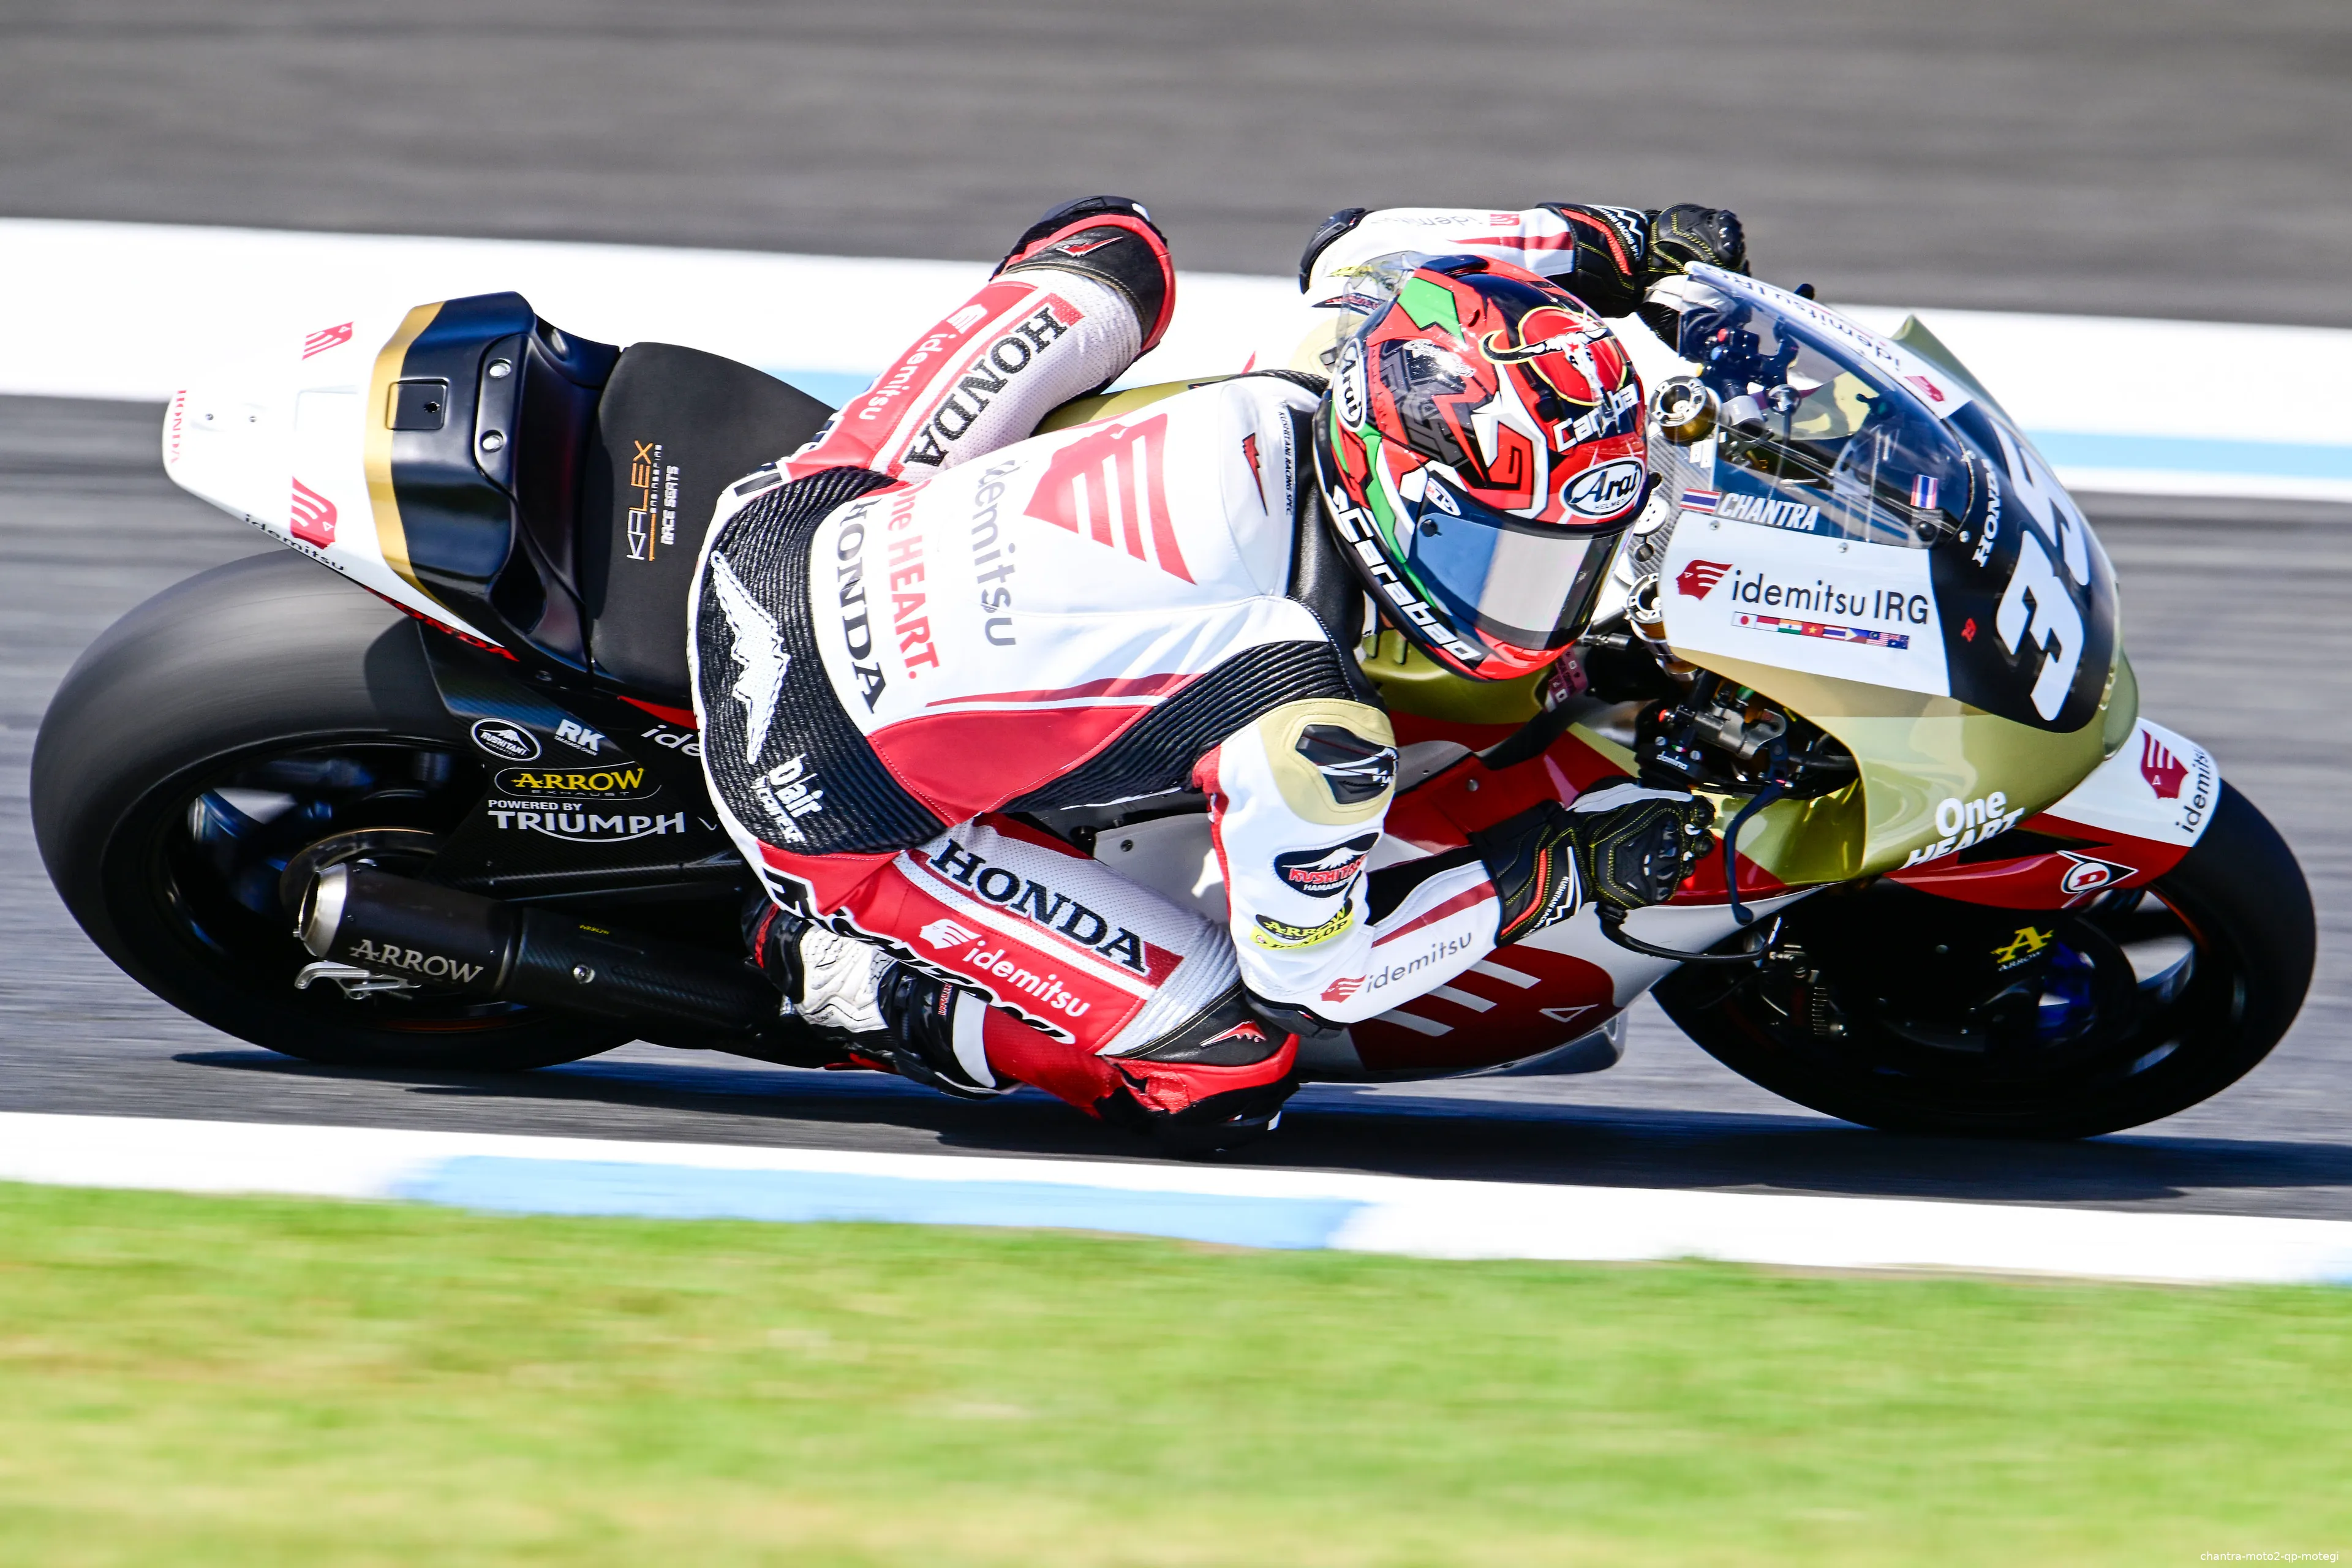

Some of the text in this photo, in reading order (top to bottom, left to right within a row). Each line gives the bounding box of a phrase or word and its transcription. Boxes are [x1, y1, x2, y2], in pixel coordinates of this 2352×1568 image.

[859, 333, 953, 421] idemitsu
[904, 306, 1068, 467] HONDA
[170, 390, 187, 464] HONDA
[627, 440, 654, 560] KALEX
[660, 465, 679, 545] RACE SEATS
[1568, 464, 1639, 503] Arai
[1717, 492, 1820, 531] CHANTRA
[1972, 459, 2001, 568] HONDA
[245, 513, 345, 572] idemitsu
[1988, 417, 2090, 722] 35
[837, 498, 887, 715] HONDA
[1339, 507, 1482, 660] Carabao
[1731, 570, 1929, 625] idemitsu IRG
[554, 718, 606, 752] RK
[488, 799, 582, 811] POWERED BY
[511, 767, 646, 791] ARROW
[2175, 745, 2211, 834] idemitsu
[488, 810, 685, 843] TRIUMPH
[1899, 807, 2025, 870] HEART
[1935, 791, 2007, 839] One
[930, 839, 1149, 975] HONDA
[349, 938, 484, 983] ARROW
[963, 940, 1091, 1018] idemitsu
[1366, 931, 1472, 993] idemitsu
